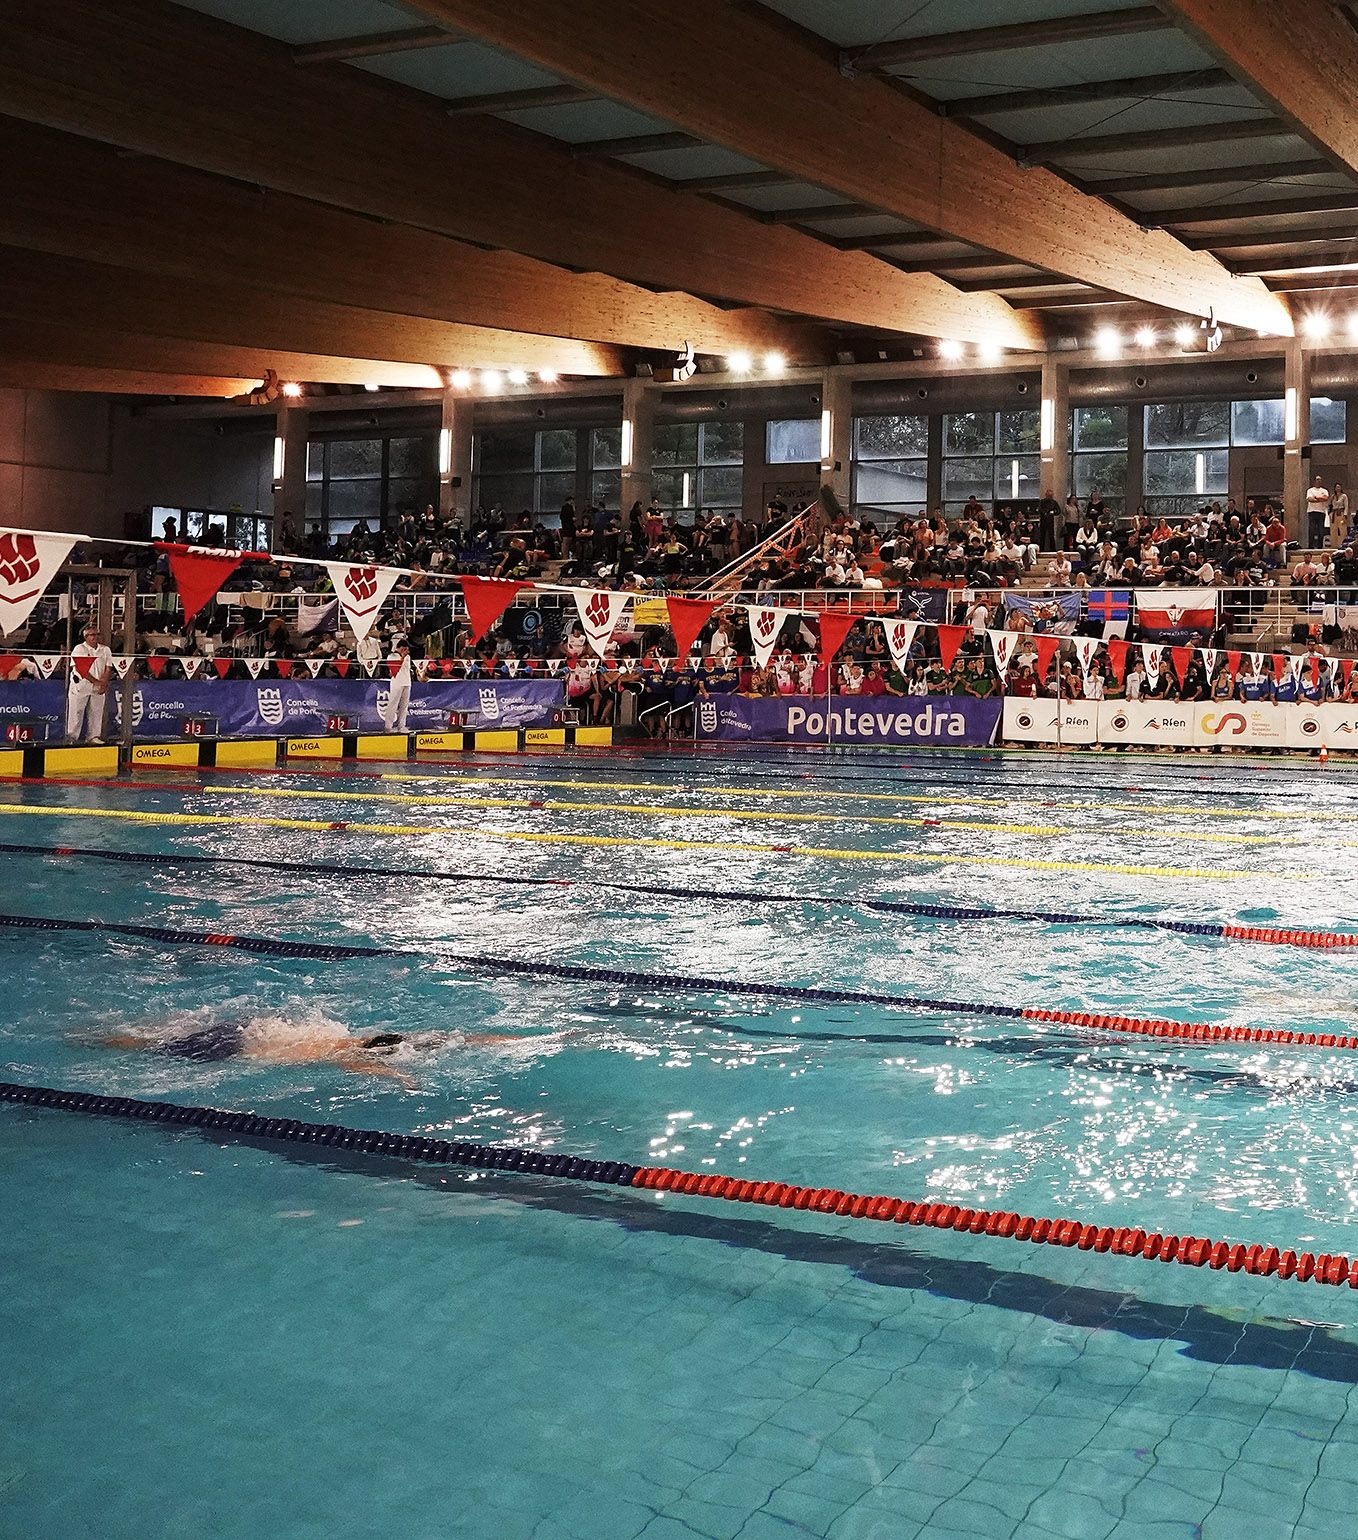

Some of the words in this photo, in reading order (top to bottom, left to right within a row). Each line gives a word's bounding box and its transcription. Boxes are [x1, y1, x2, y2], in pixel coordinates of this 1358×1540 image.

[148, 701, 184, 710] Concello
[148, 710, 159, 719] de
[329, 719, 335, 729] 2
[787, 704, 966, 736] Pontevedra
[184, 723, 190, 734] 3
[8, 729, 15, 740] 4
[20, 730, 28, 740] 4
[419, 737, 444, 745] OMEGA
[290, 742, 320, 751] OMEGA
[136, 749, 171, 758] OMEGA
